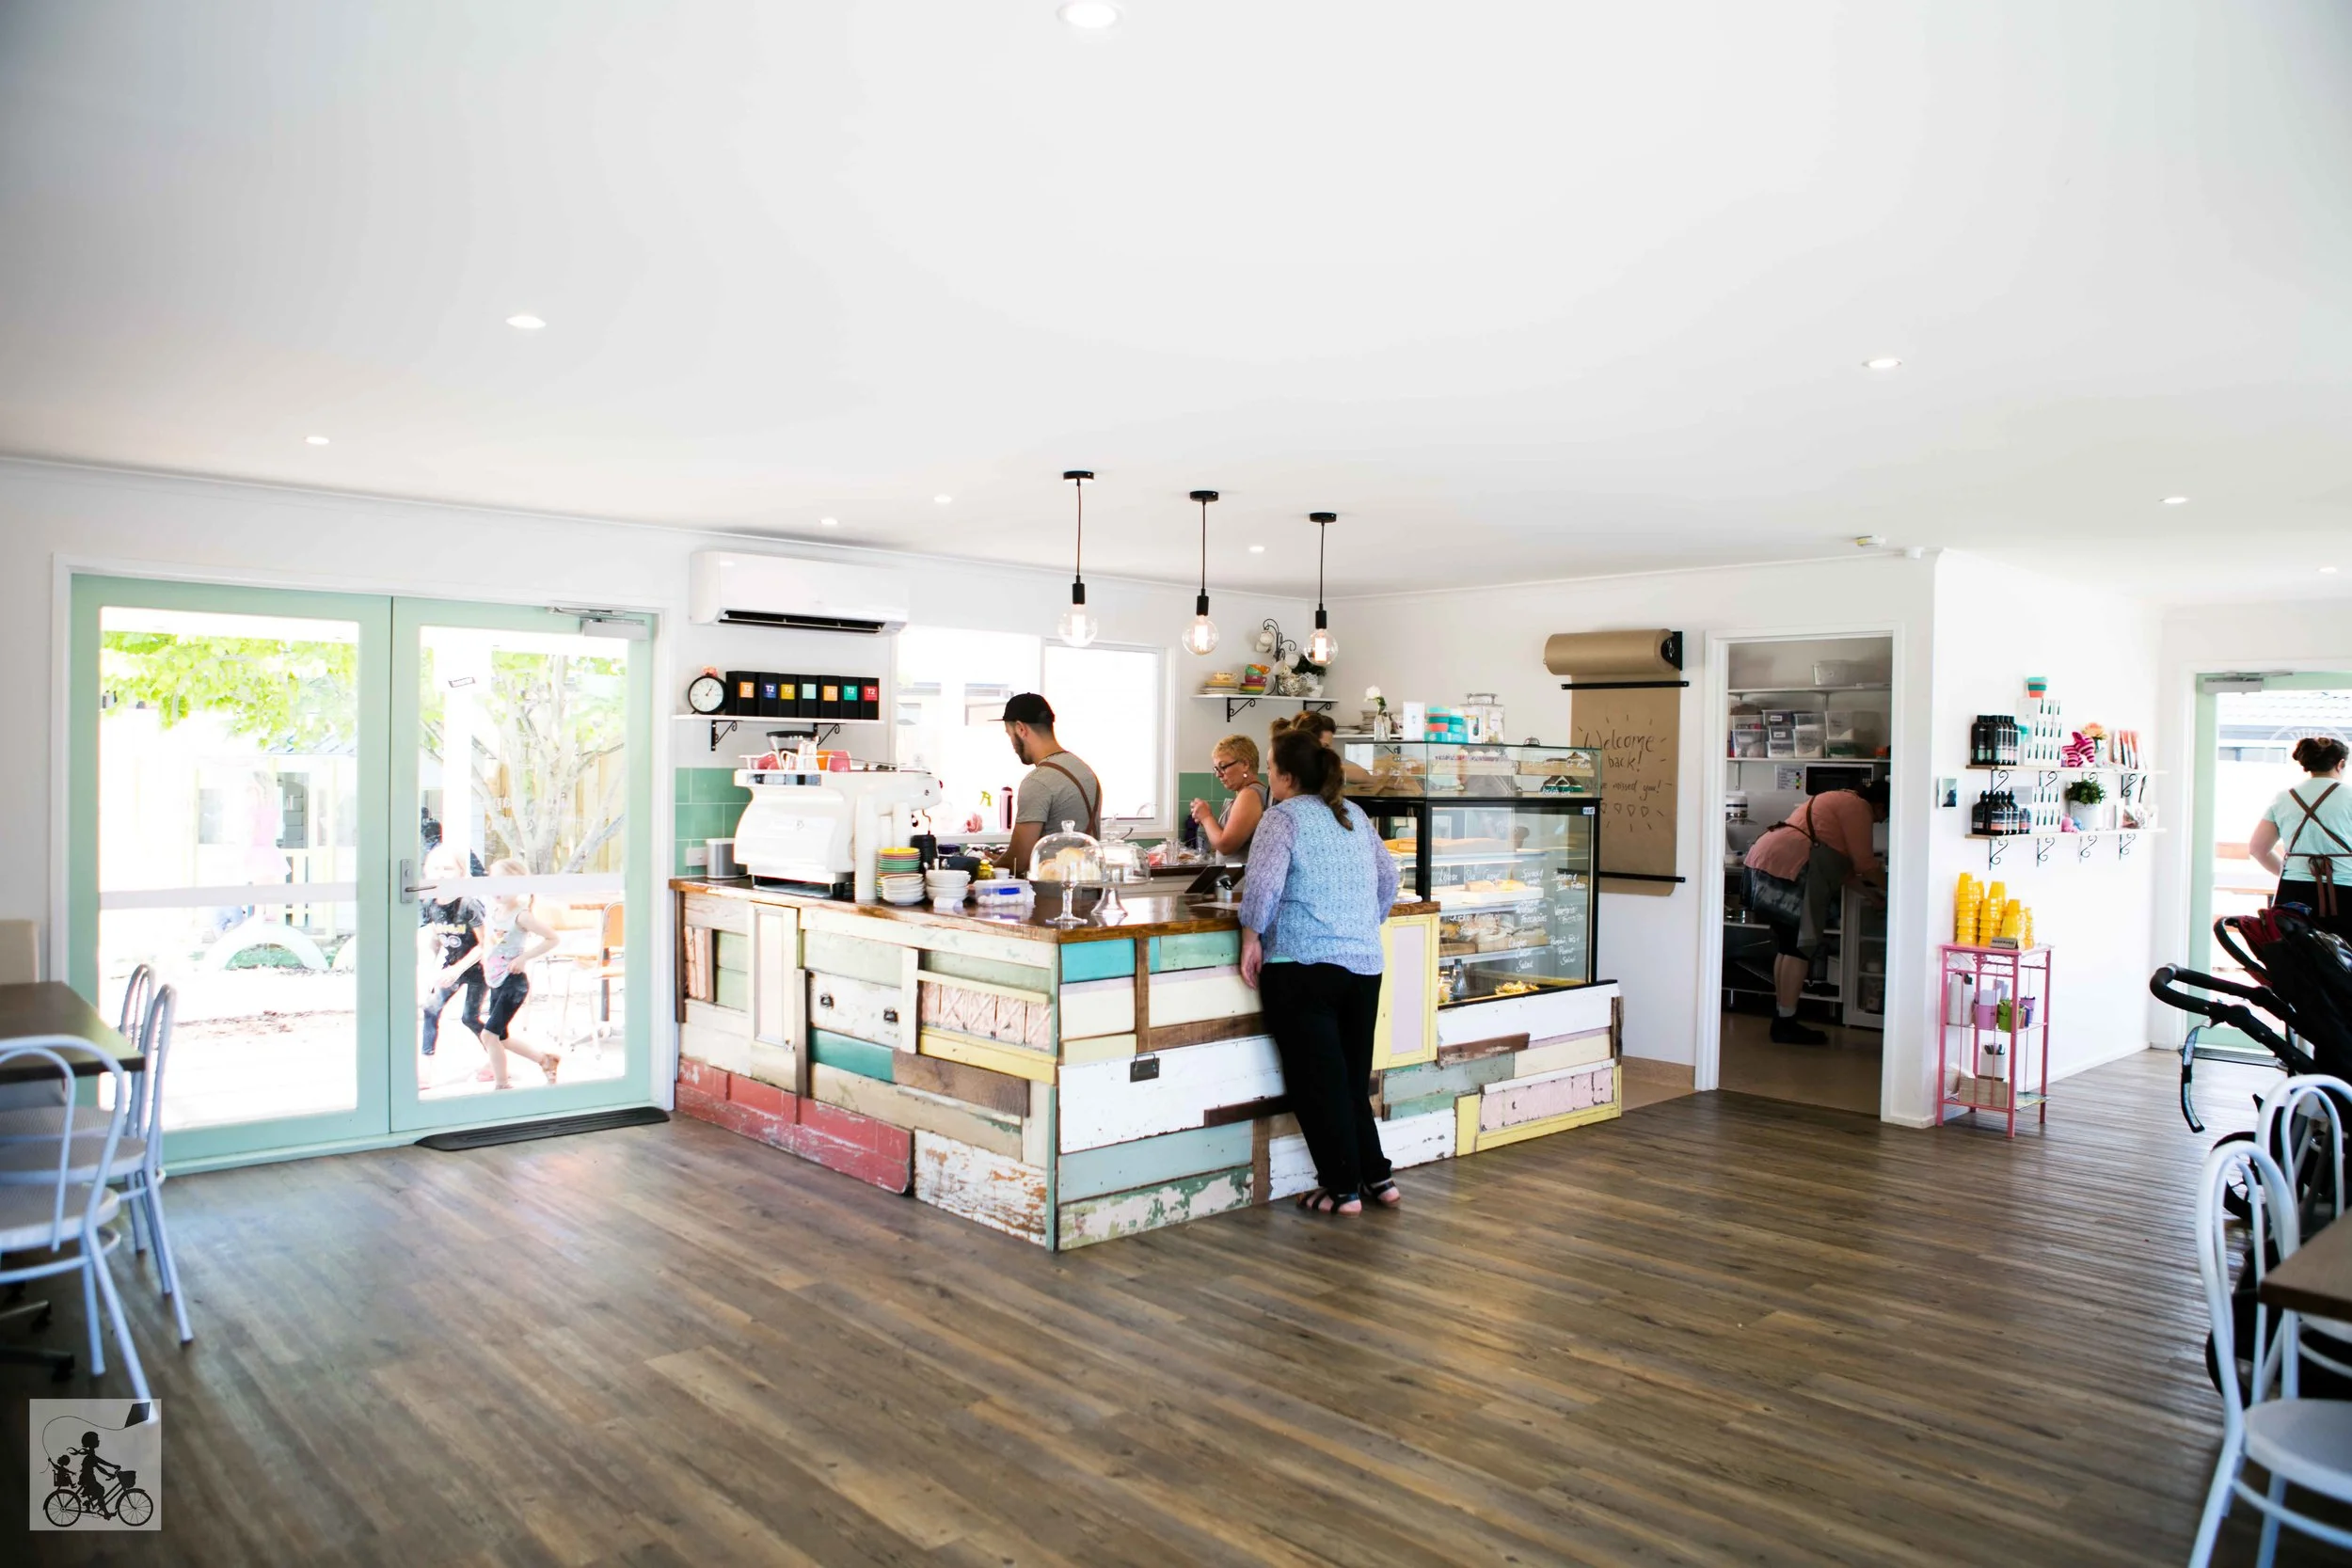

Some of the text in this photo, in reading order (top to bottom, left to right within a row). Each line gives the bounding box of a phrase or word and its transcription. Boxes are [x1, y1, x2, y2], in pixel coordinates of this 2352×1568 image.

[1583, 729, 1655, 756] Welcome
[1607, 751, 1643, 772] back!
[1613, 780, 1638, 791] missed
[1639, 779, 1661, 801] you!
